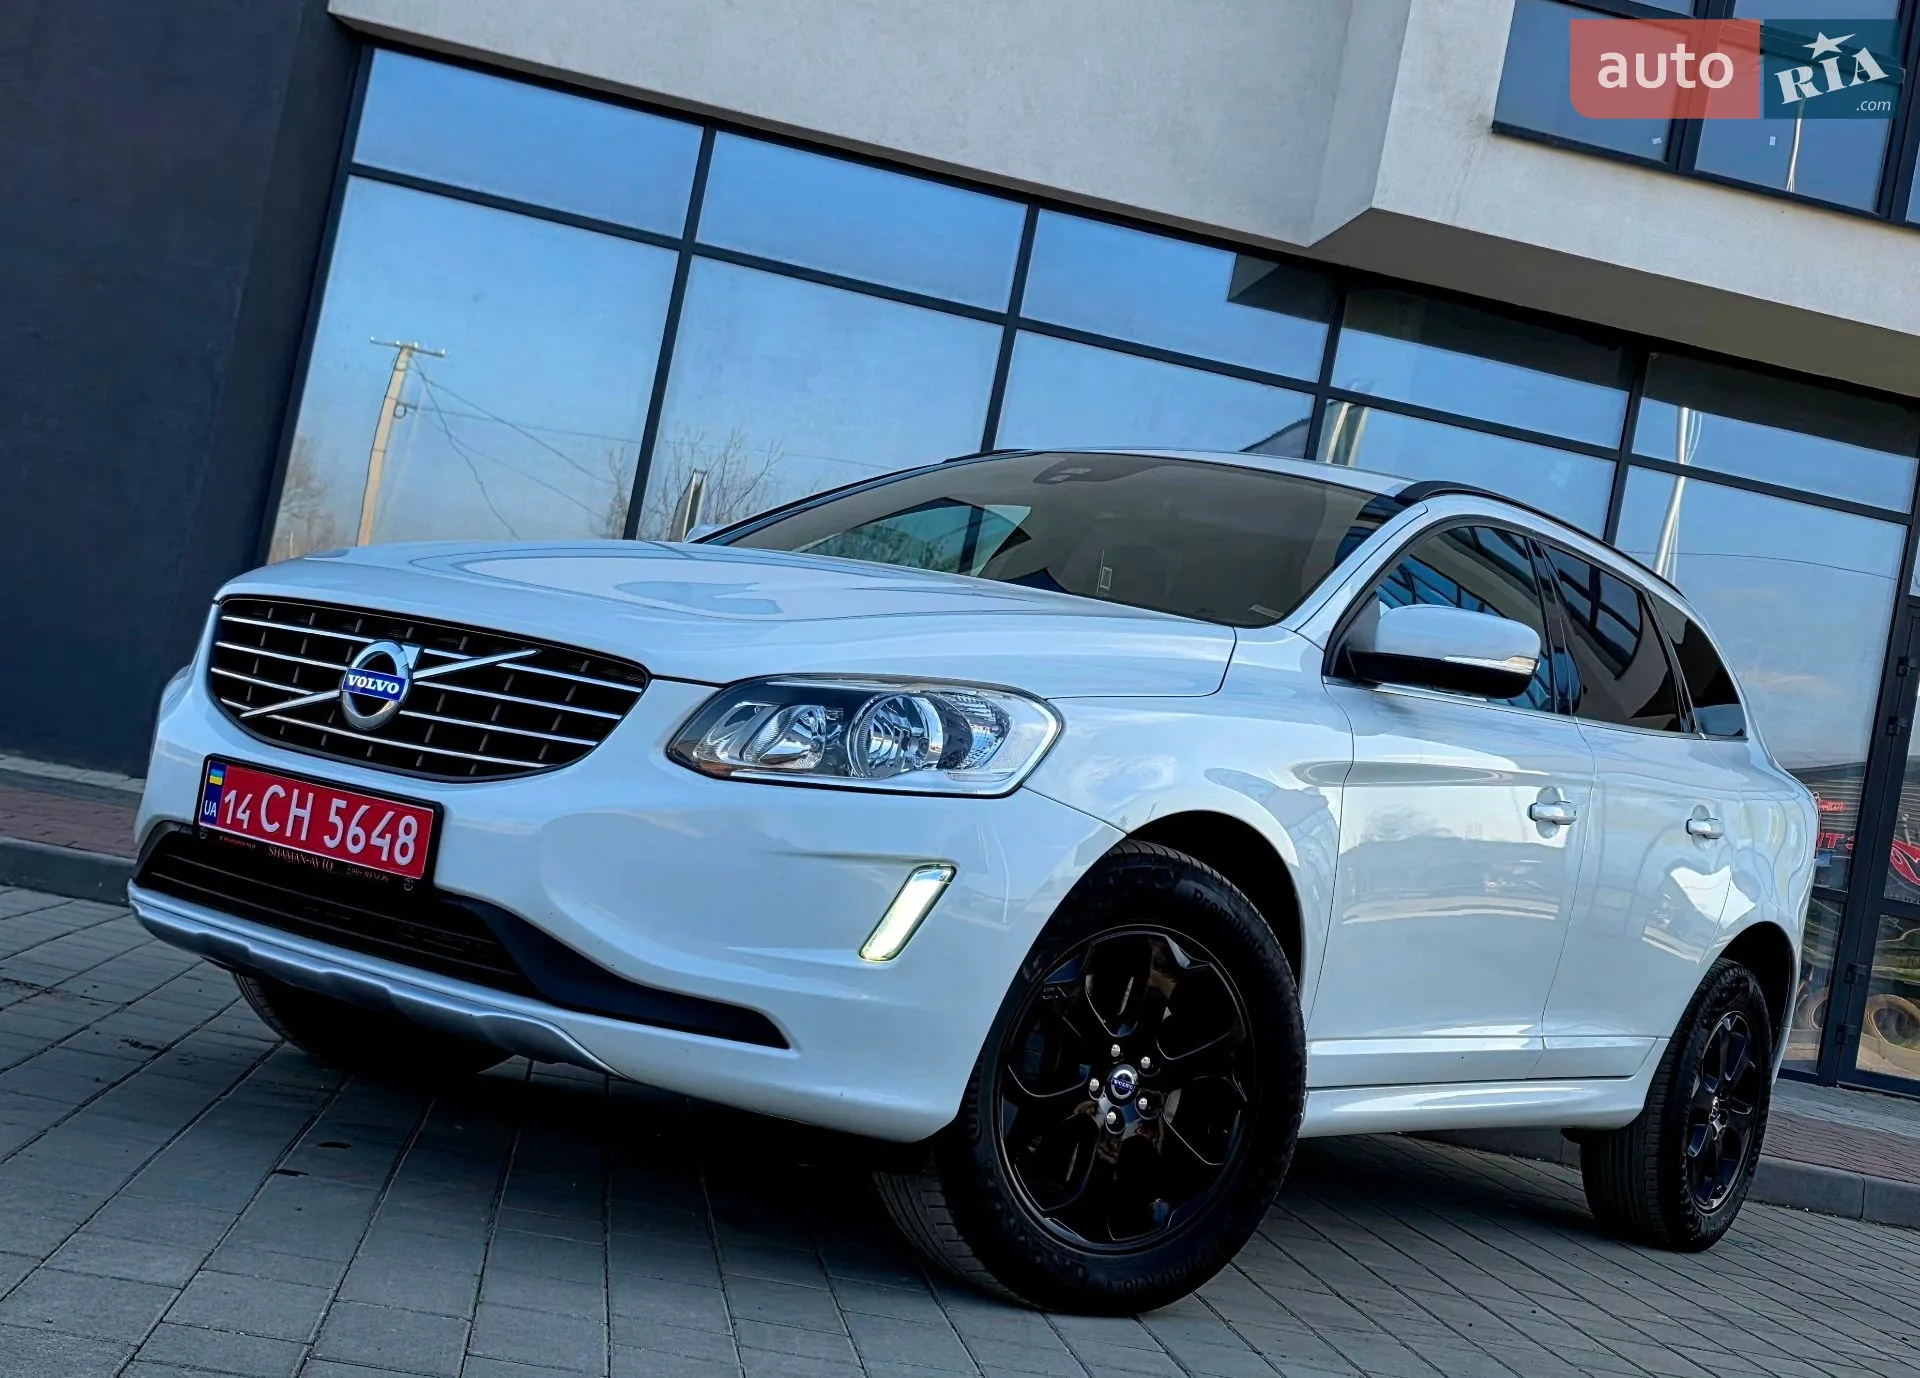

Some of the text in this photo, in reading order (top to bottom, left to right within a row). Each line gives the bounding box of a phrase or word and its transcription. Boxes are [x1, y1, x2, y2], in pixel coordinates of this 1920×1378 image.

[348, 674, 400, 695] VOLVO
[204, 799, 217, 817] UA
[224, 784, 418, 866] 14 CH 5648
[1113, 1078, 1133, 1091] VOLVO
